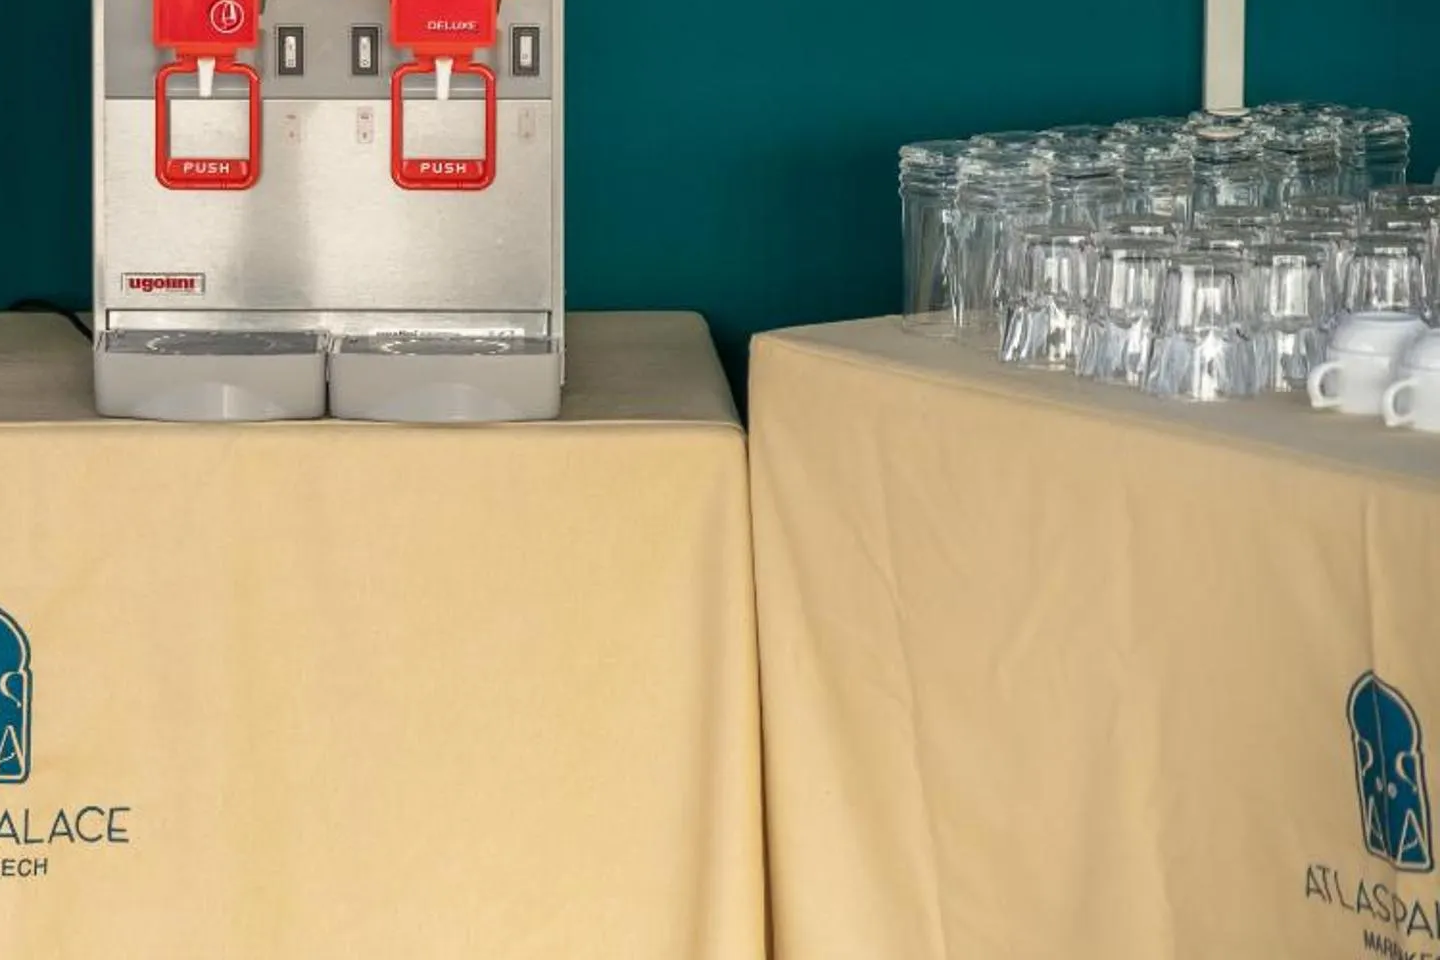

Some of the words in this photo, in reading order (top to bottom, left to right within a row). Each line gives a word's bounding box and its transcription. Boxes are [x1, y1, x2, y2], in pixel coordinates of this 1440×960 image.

[426, 20, 477, 31] DELUXE
[183, 161, 230, 175] PUSH
[420, 162, 467, 175] PUSH
[128, 277, 195, 292] ugolini
[1305, 865, 1390, 922] ATLAS
